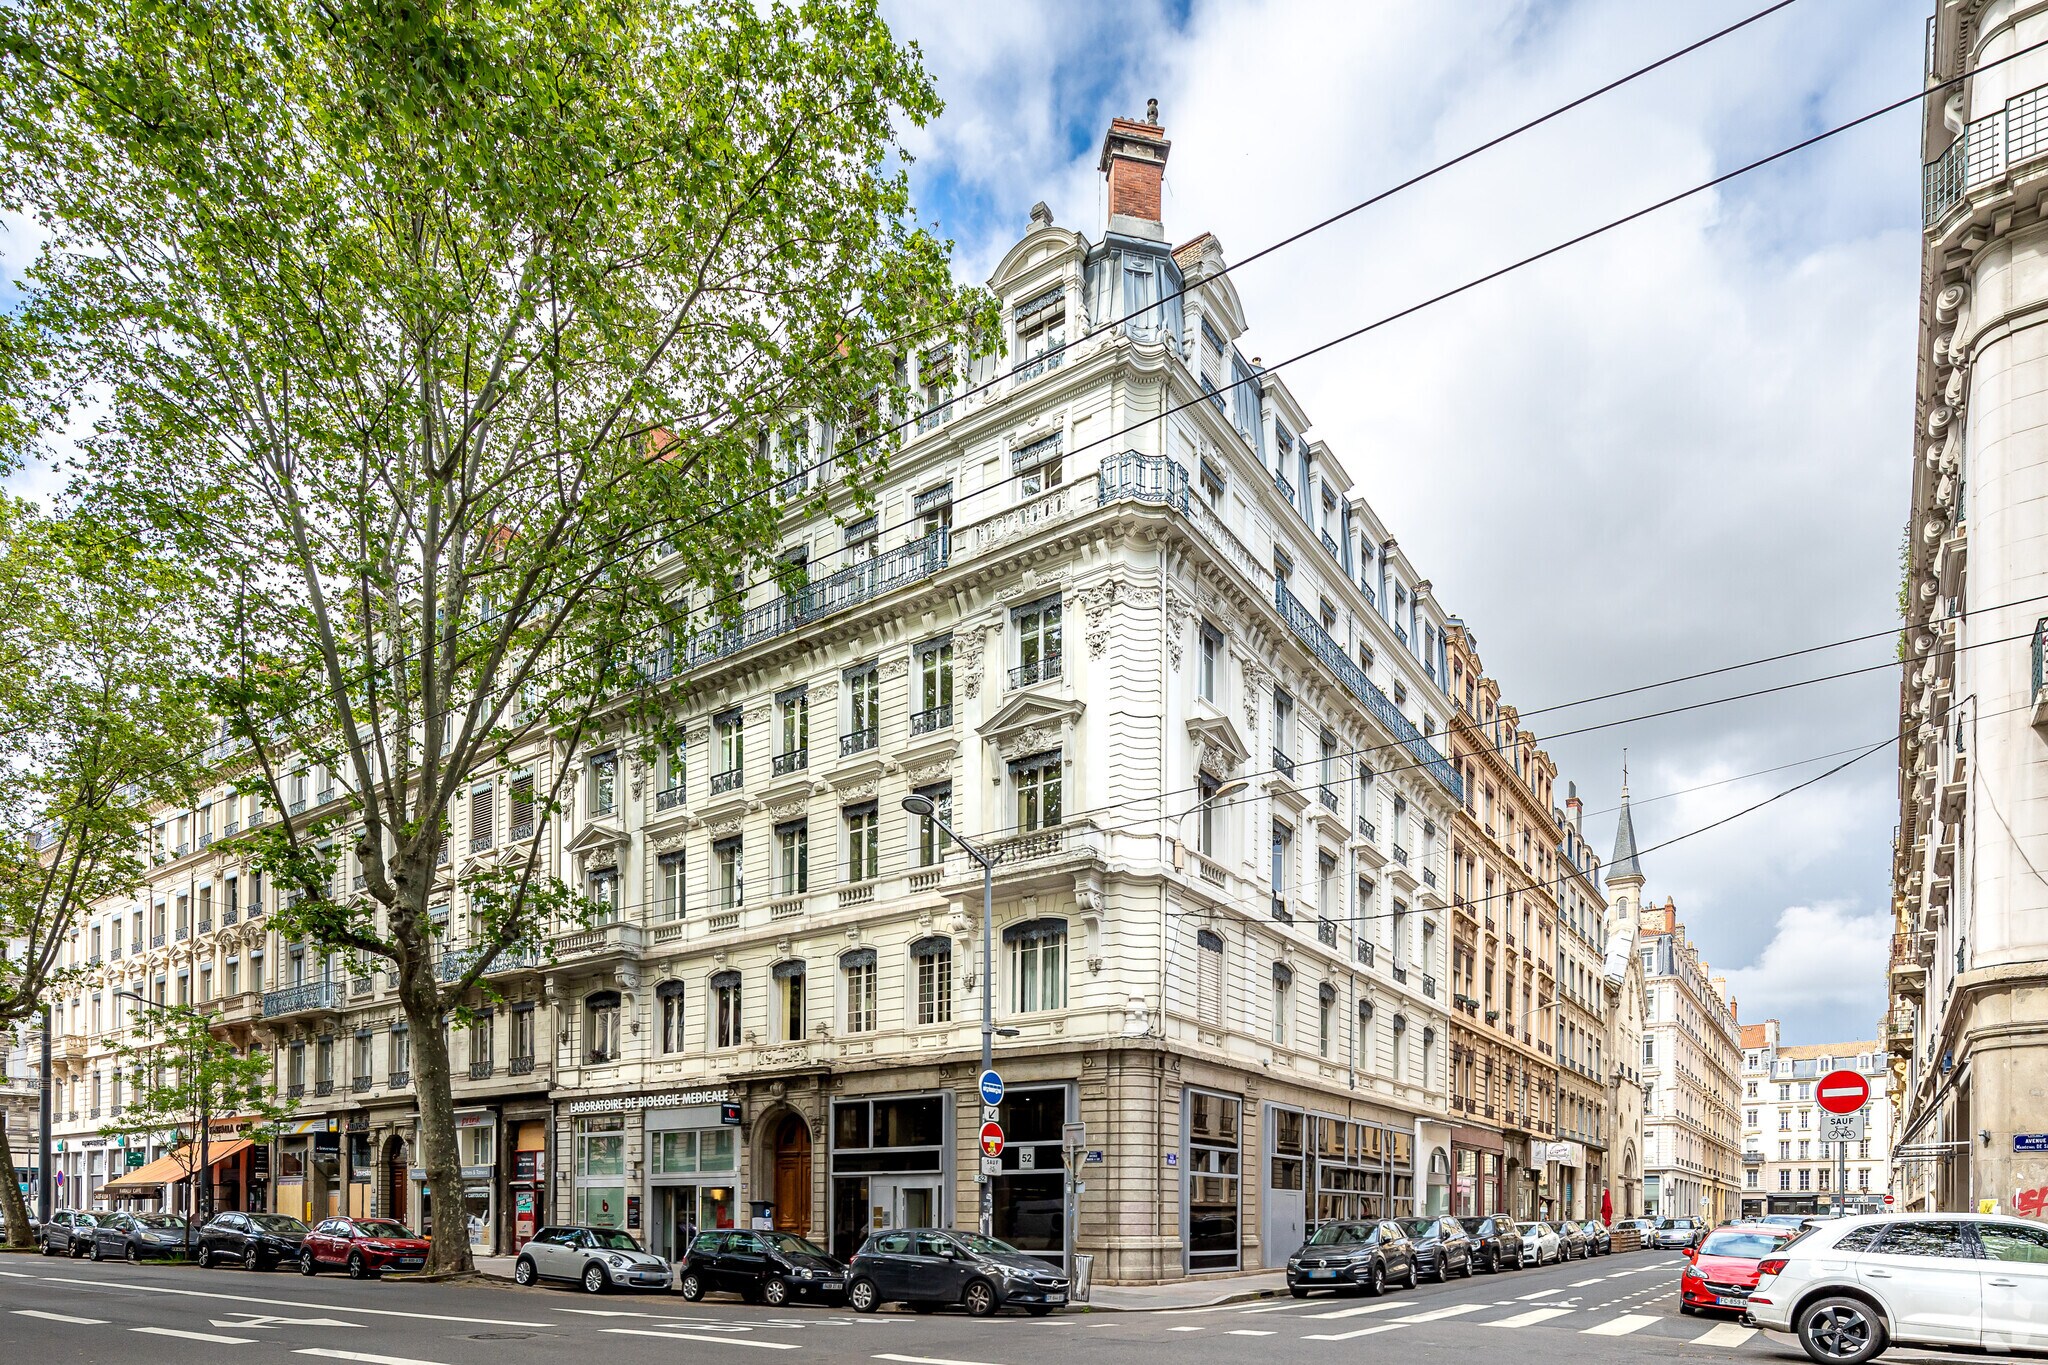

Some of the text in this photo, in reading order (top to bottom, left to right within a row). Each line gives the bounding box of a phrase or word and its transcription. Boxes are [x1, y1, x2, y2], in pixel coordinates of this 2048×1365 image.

[570, 1089, 729, 1113] LABORATOIRE DE BIOLOGIE MEDICALE
[1830, 1117, 1854, 1125] SAUF
[1022, 1154, 1032, 1163] 52
